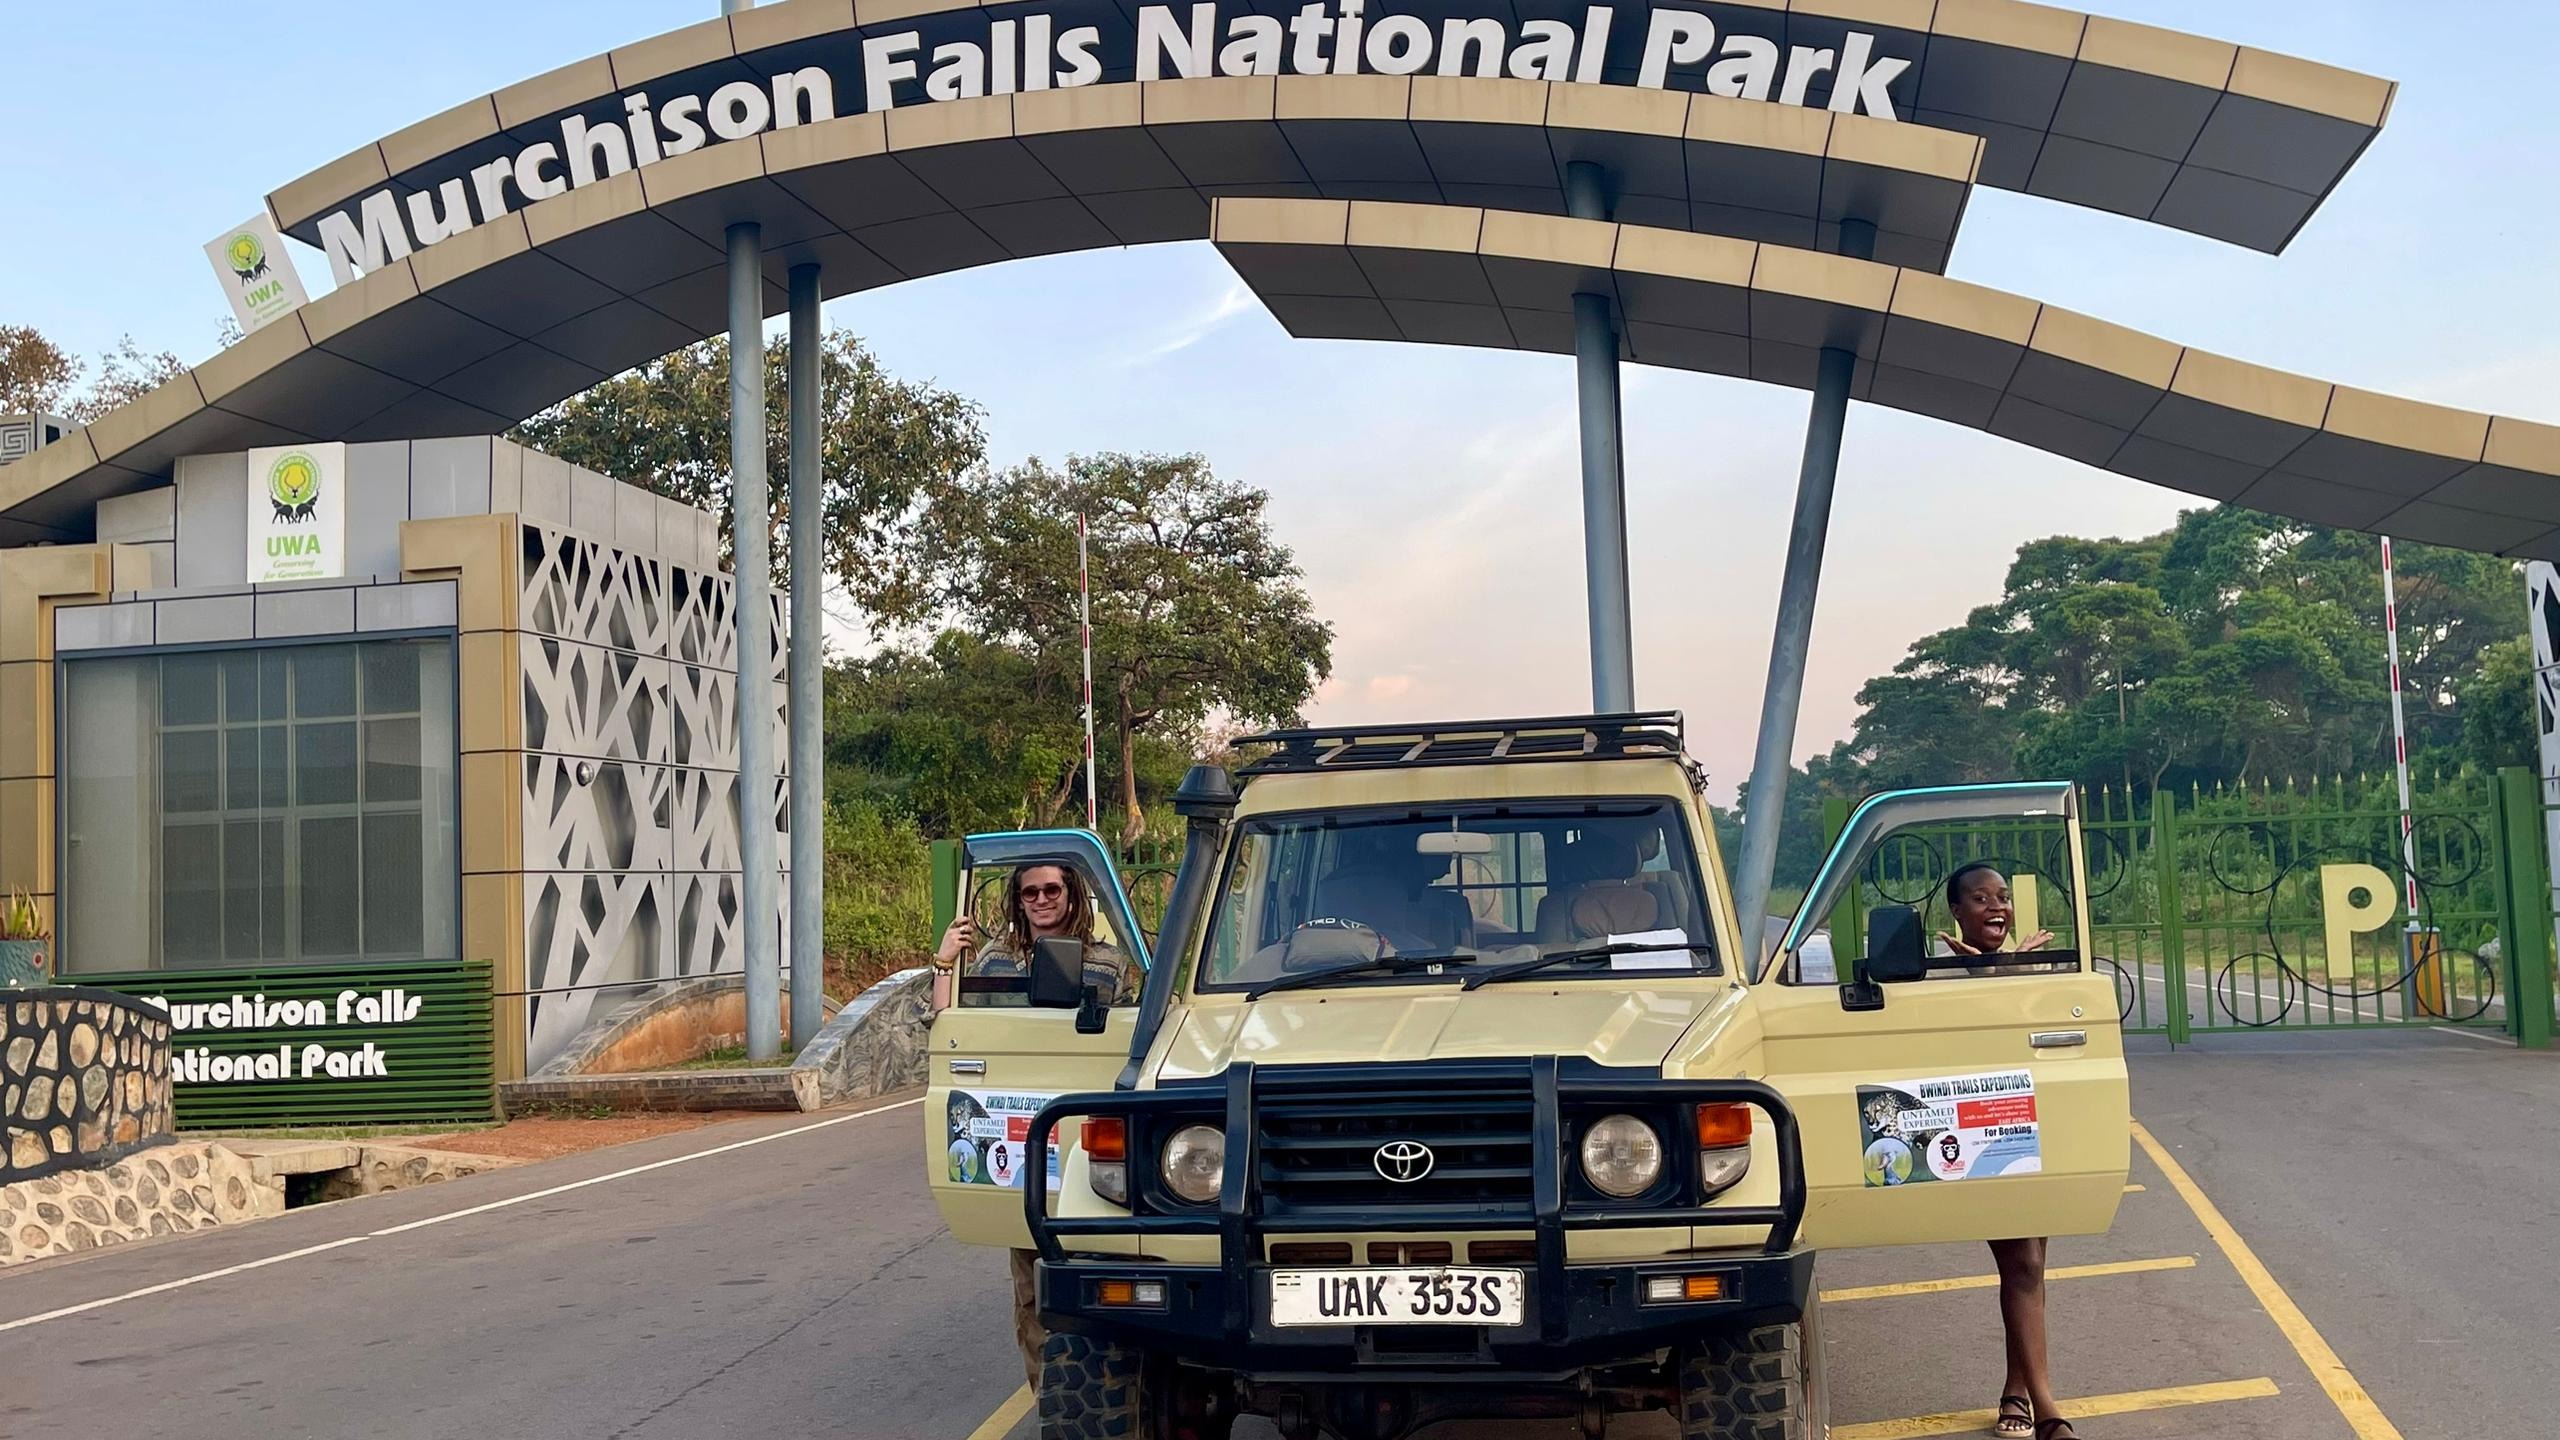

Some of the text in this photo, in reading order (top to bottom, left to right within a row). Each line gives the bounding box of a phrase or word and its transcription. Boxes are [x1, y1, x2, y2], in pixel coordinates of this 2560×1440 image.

[317, 0, 1911, 289] Murchison Falls National Park
[244, 279, 284, 308] UWA
[266, 534, 321, 556] UWA
[2321, 864, 2398, 979] P
[337, 989, 422, 1024] Falls
[171, 1042, 388, 1082] ational Park
[1920, 1074, 2031, 1099] BWINDI TRAILS EXPEDITIONS
[1902, 1107, 1954, 1120] UNTAMED
[1903, 1117, 1954, 1129] EXPERIENCE
[1984, 1125, 2032, 1137] For Booking
[1318, 1275, 1502, 1317] UAK 353S
